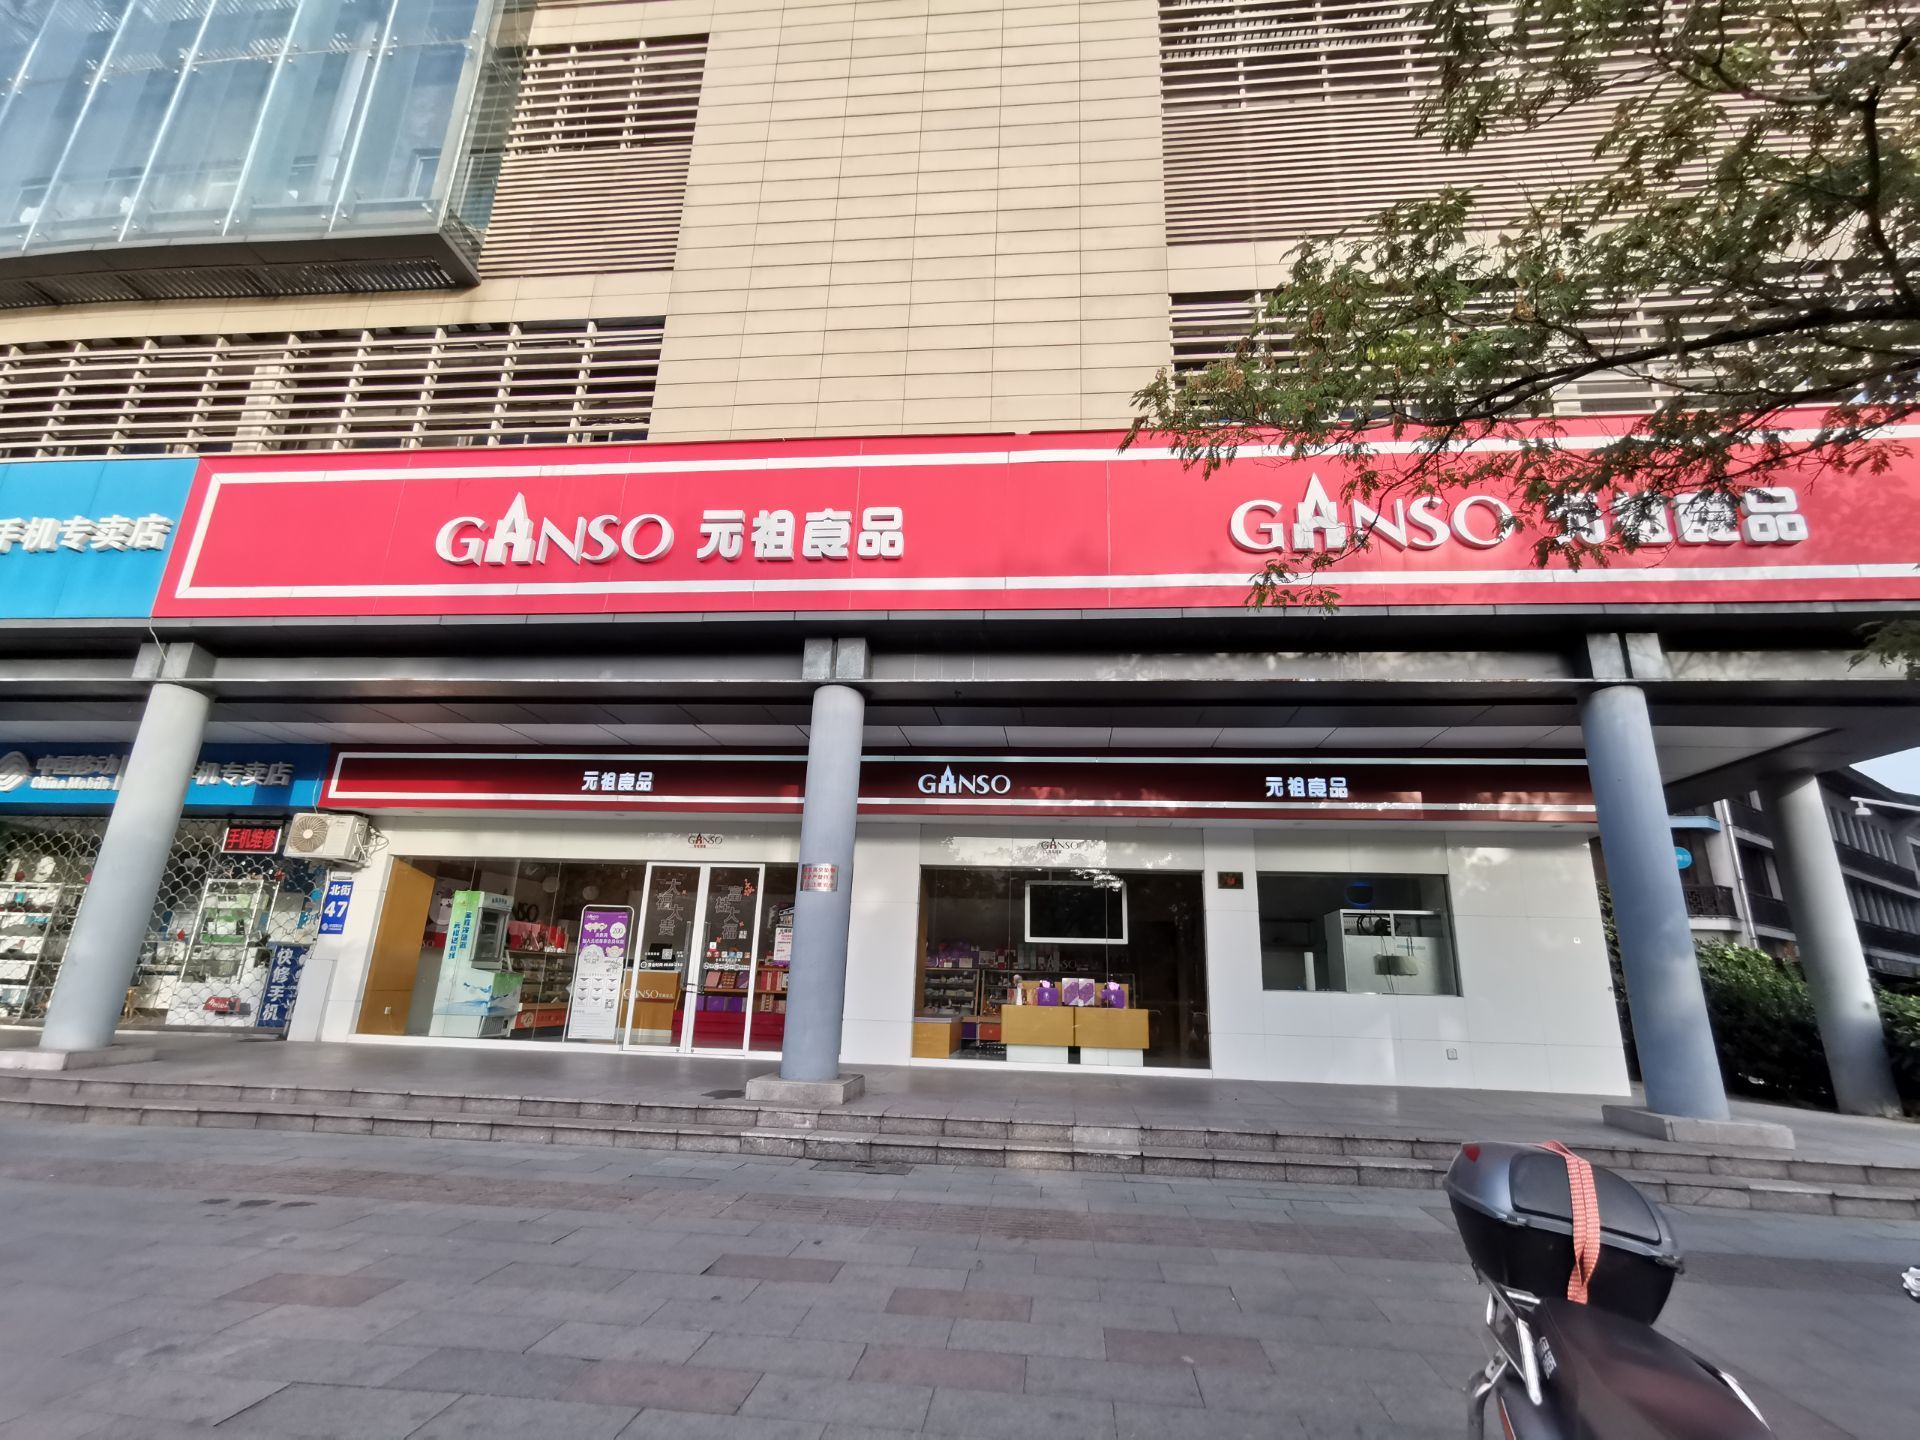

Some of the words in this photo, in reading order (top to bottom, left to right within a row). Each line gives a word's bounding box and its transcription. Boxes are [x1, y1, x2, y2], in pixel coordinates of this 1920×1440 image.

[1228, 472, 1516, 553] GANSO
[435, 491, 674, 567] GANSO
[697, 506, 904, 562] 元祖食品
[193, 761, 294, 786] 机专卖店
[581, 770, 654, 792] 元祖食品
[917, 763, 1012, 795] GANSO
[1265, 776, 1349, 799] 元祖食品
[226, 828, 277, 850] 手机维修
[687, 832, 723, 845] GANSO
[1040, 837, 1080, 850] GANSO
[328, 884, 352, 896] 北街
[323, 900, 349, 918] 47
[261, 947, 294, 1021] 快修手机
[624, 988, 659, 999] GNSO
